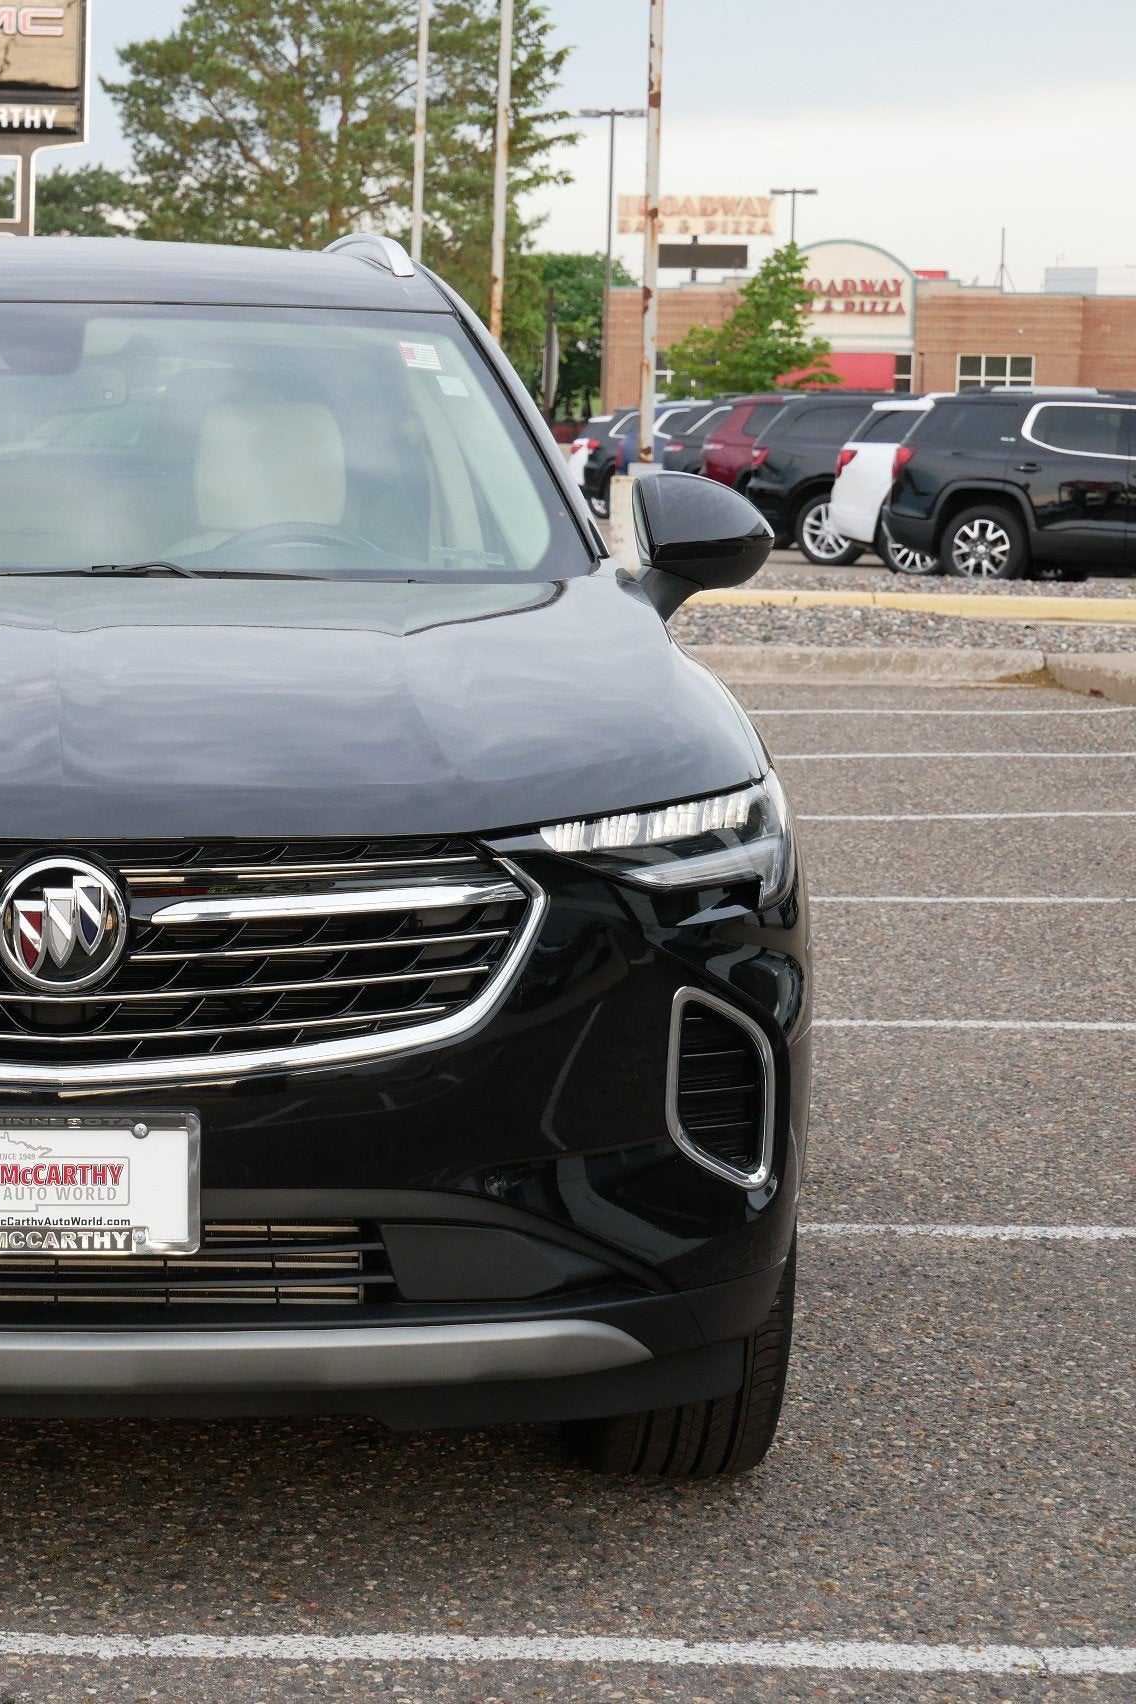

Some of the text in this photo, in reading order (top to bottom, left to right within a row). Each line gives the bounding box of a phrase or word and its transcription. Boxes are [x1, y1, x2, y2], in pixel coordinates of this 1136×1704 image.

[705, 220, 772, 235] PIZZA
[843, 300, 905, 315] PIZZA
[0, 1164, 123, 1186] McCARTHY
[3, 1187, 117, 1200] AUTO WORLD
